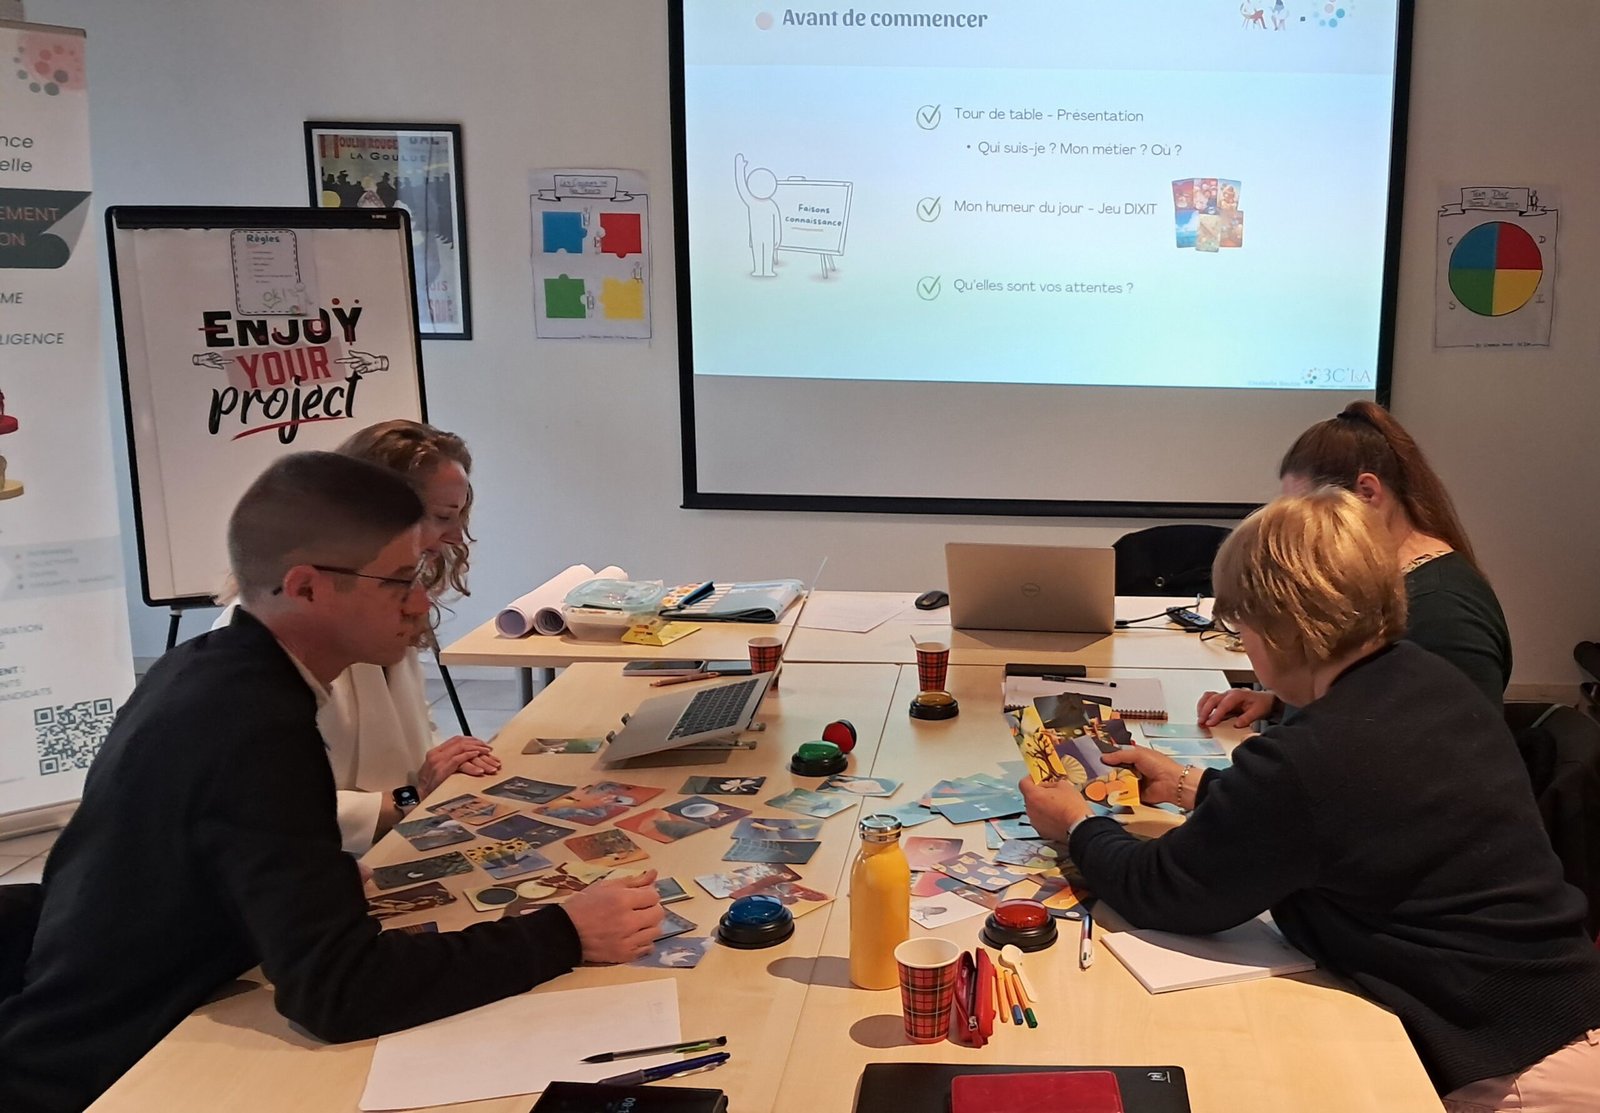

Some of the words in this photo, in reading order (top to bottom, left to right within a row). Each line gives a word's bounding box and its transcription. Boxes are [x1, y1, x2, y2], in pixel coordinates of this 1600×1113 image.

[782, 8, 838, 26] Avant
[843, 8, 866, 26] de
[870, 12, 988, 28] commencer
[954, 106, 985, 120] Tour
[989, 107, 1006, 120] de
[1010, 108, 1043, 121] table
[1057, 108, 1144, 122] Présentation
[978, 141, 1000, 156] Qui
[1004, 142, 1046, 157] suis-je
[1060, 143, 1089, 155] Mon
[1092, 143, 1136, 156] métier
[1151, 143, 1171, 156] Où
[798, 203, 830, 214] Faisons
[954, 200, 983, 212] Mon
[985, 200, 1036, 213] humeur
[1039, 201, 1055, 214] du
[1057, 202, 1084, 216] jour
[1098, 203, 1121, 215] Jeu
[1124, 203, 1158, 215] DIXIT
[785, 215, 842, 227] connaissance
[246, 232, 280, 245] Règles
[953, 279, 1004, 293] Qu'elles
[1007, 281, 1036, 292] sont
[1040, 282, 1062, 292] vos
[1065, 282, 1123, 294] attentes
[200, 304, 363, 348] ENJOY
[236, 346, 331, 388] YOUR
[208, 371, 363, 444] project
